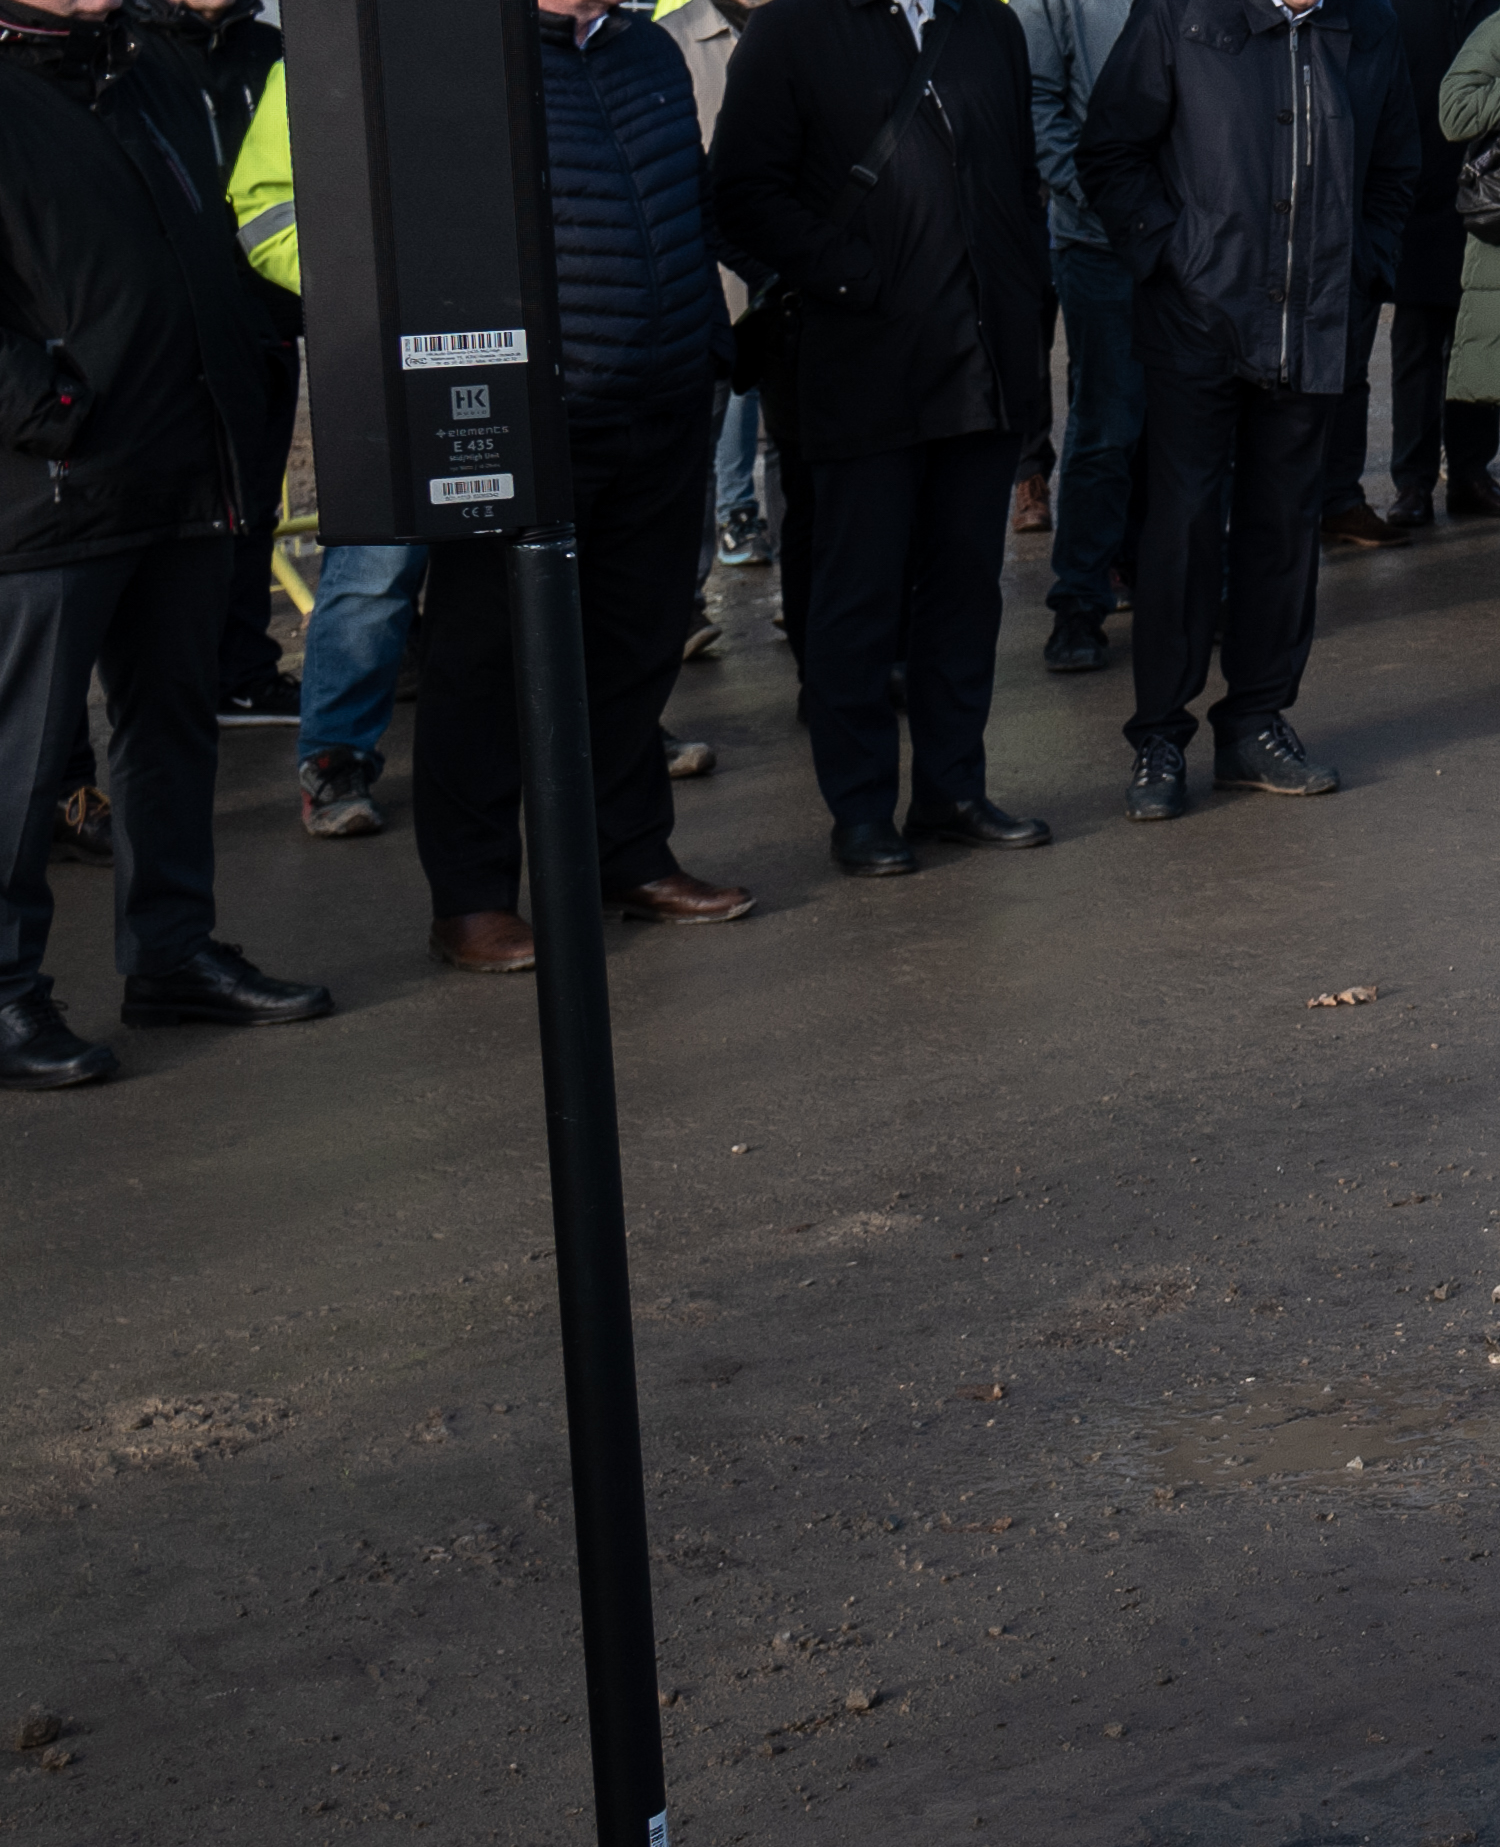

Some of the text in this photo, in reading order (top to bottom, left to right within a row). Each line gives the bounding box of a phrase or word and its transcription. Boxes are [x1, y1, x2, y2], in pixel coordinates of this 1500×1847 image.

[455, 389, 486, 410] HK
[448, 425, 509, 437] elements
[454, 439, 494, 452] E 435
